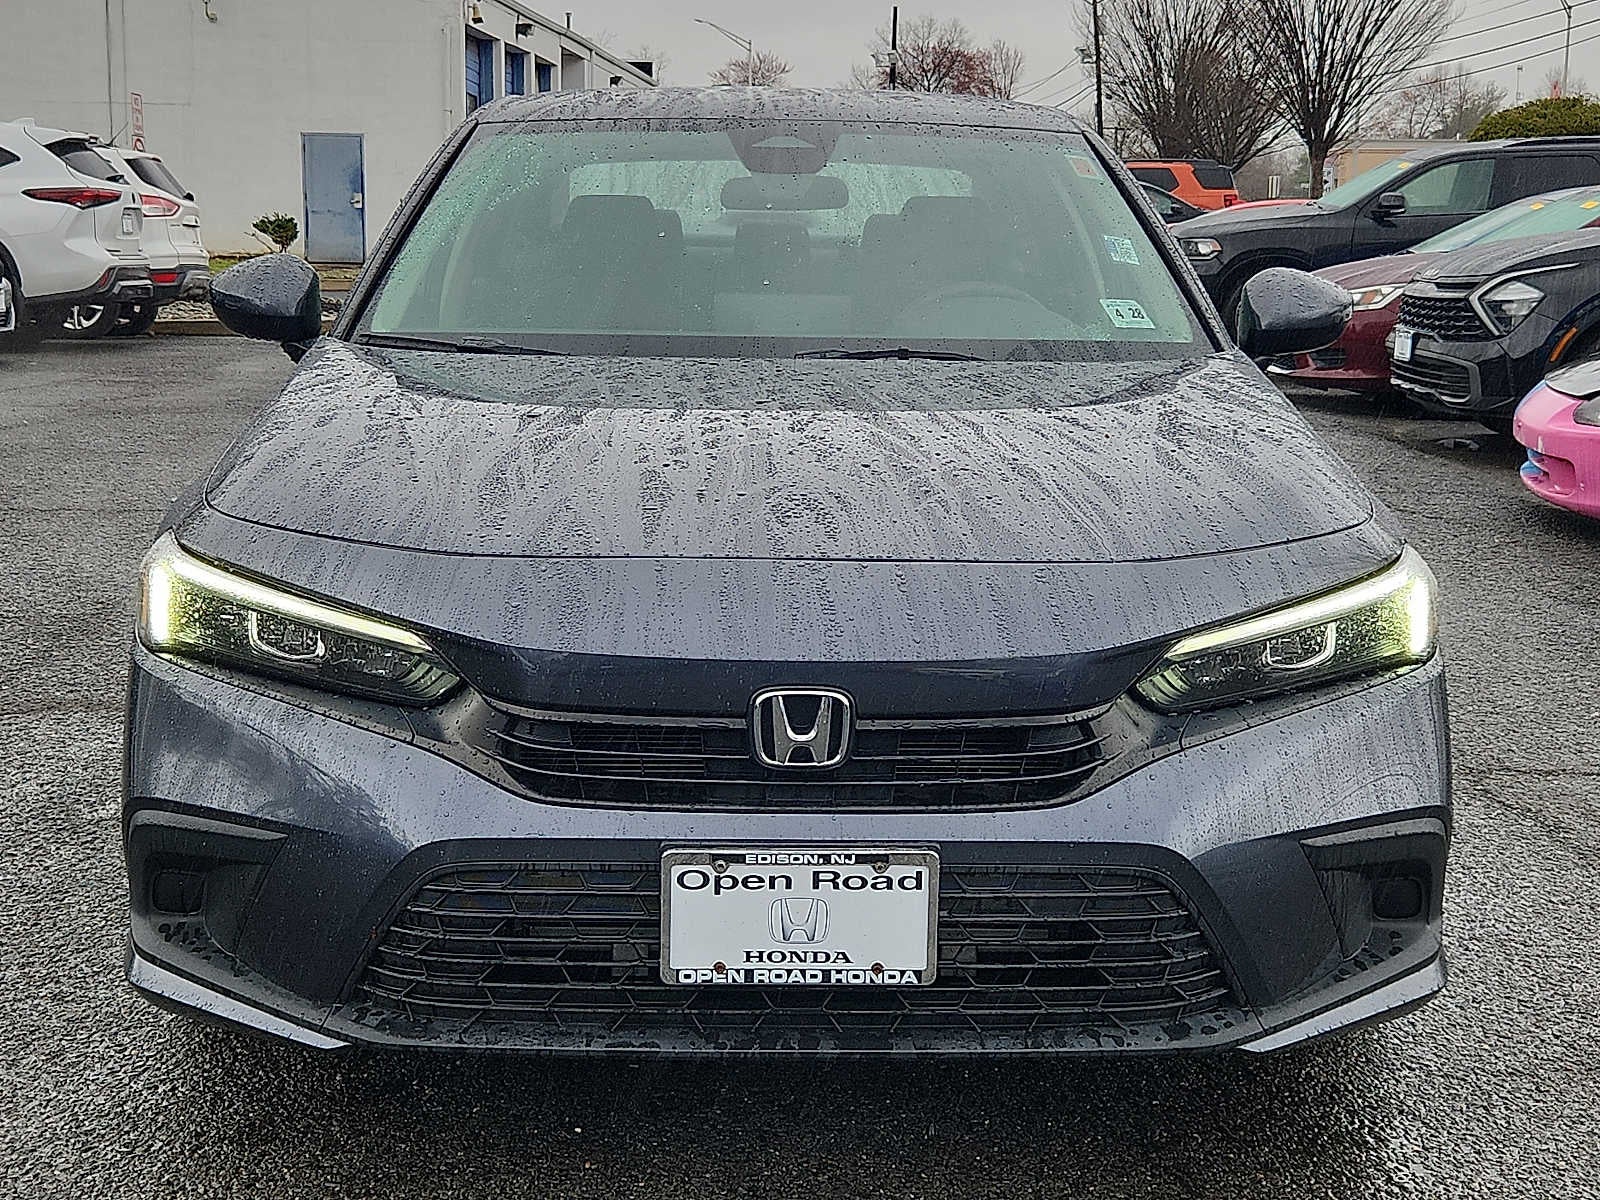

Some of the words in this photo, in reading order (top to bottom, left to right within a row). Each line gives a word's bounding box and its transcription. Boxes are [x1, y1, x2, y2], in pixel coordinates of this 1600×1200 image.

[1128, 308, 1145, 319] 28
[745, 854, 824, 865] EDISON,
[830, 854, 856, 865] NJ
[676, 869, 793, 896] Open
[812, 870, 923, 890] Road
[743, 950, 854, 964] HONDA
[678, 969, 745, 984] OPEN
[753, 969, 823, 984] ROAD
[830, 970, 919, 984] HONDA
